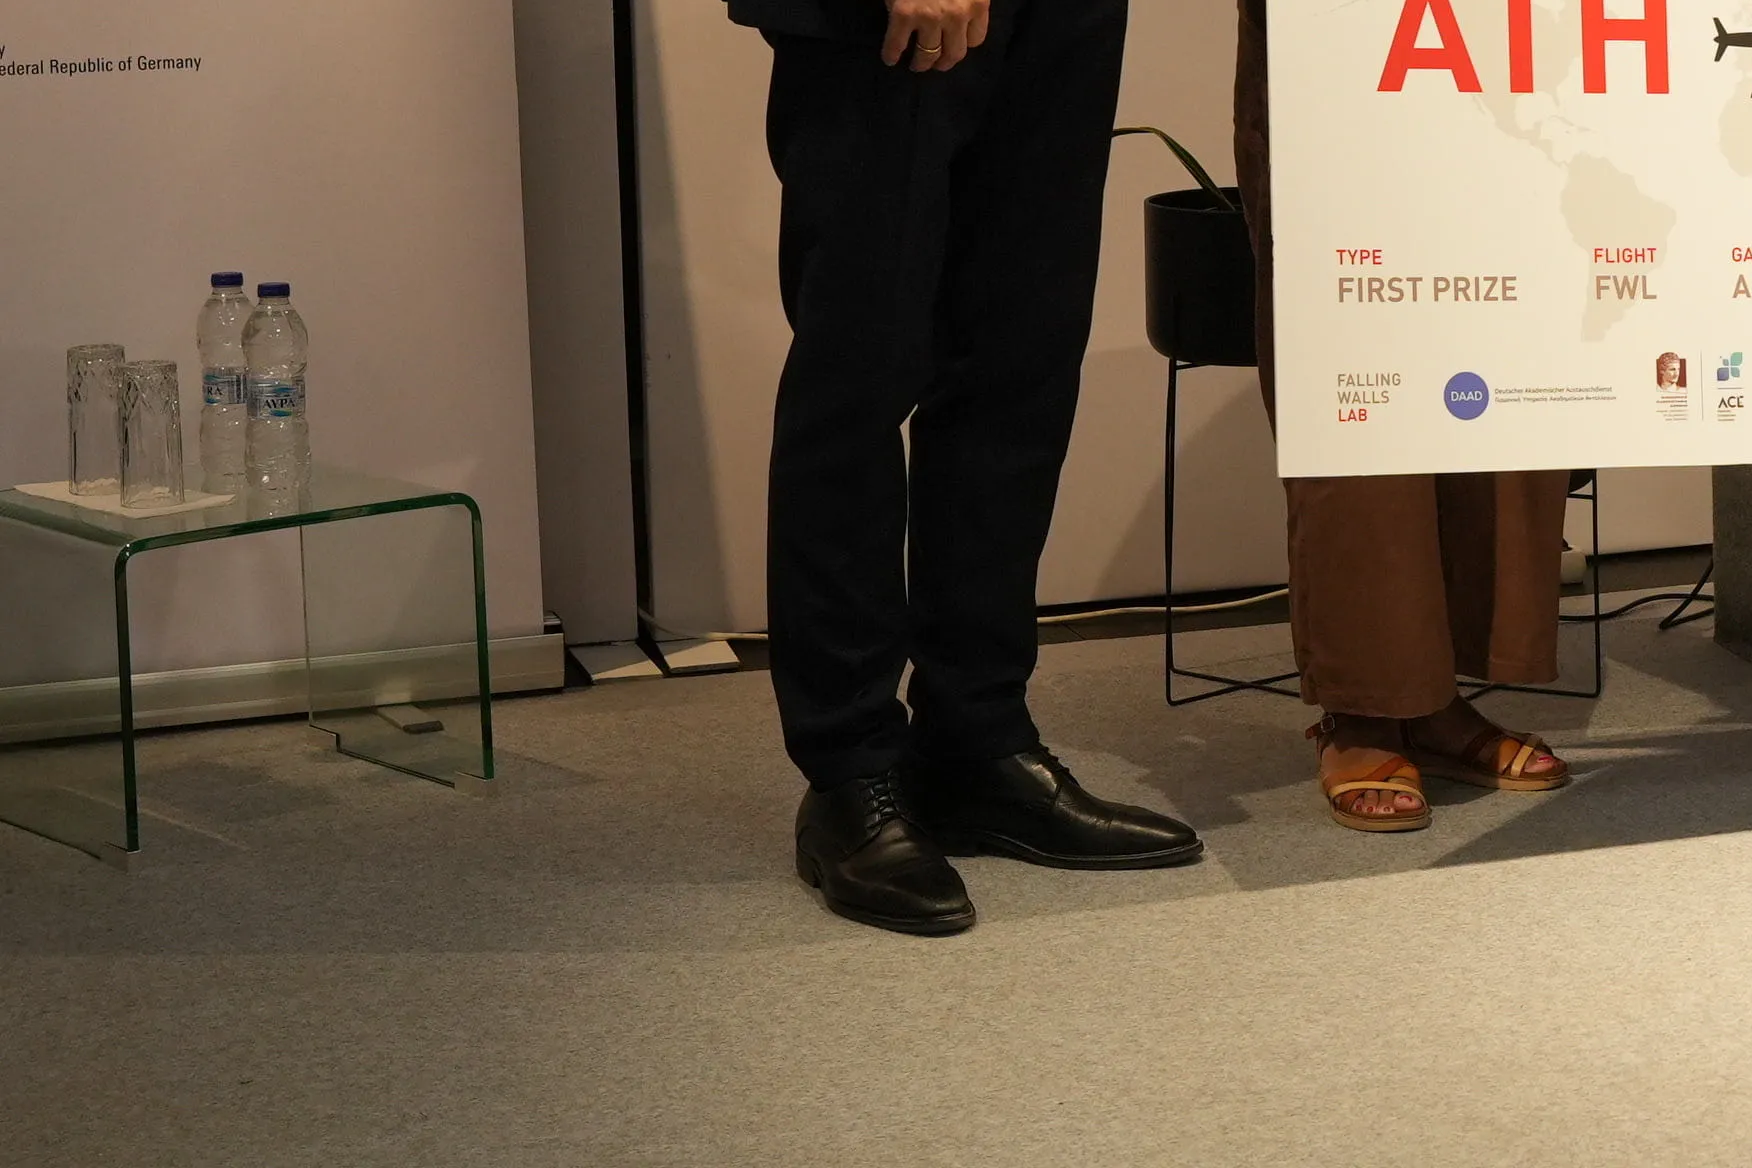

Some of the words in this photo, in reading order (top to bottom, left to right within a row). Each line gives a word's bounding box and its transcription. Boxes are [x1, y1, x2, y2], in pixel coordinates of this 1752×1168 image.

[0, 60, 44, 76] ederal
[49, 57, 113, 77] Republic
[118, 56, 133, 71] of
[137, 55, 202, 71] Germany
[1336, 249, 1383, 265] TYPE
[1593, 247, 1657, 263] FLIGHT
[1337, 277, 1423, 303] FIRST
[1433, 276, 1518, 302] PRIZE
[1595, 275, 1658, 300] FWL
[1337, 373, 1401, 387] FALLING
[1337, 390, 1390, 405] WALLS
[1450, 391, 1483, 402] DAAD
[1718, 395, 1744, 409] ACE
[1338, 408, 1368, 422] LAB
